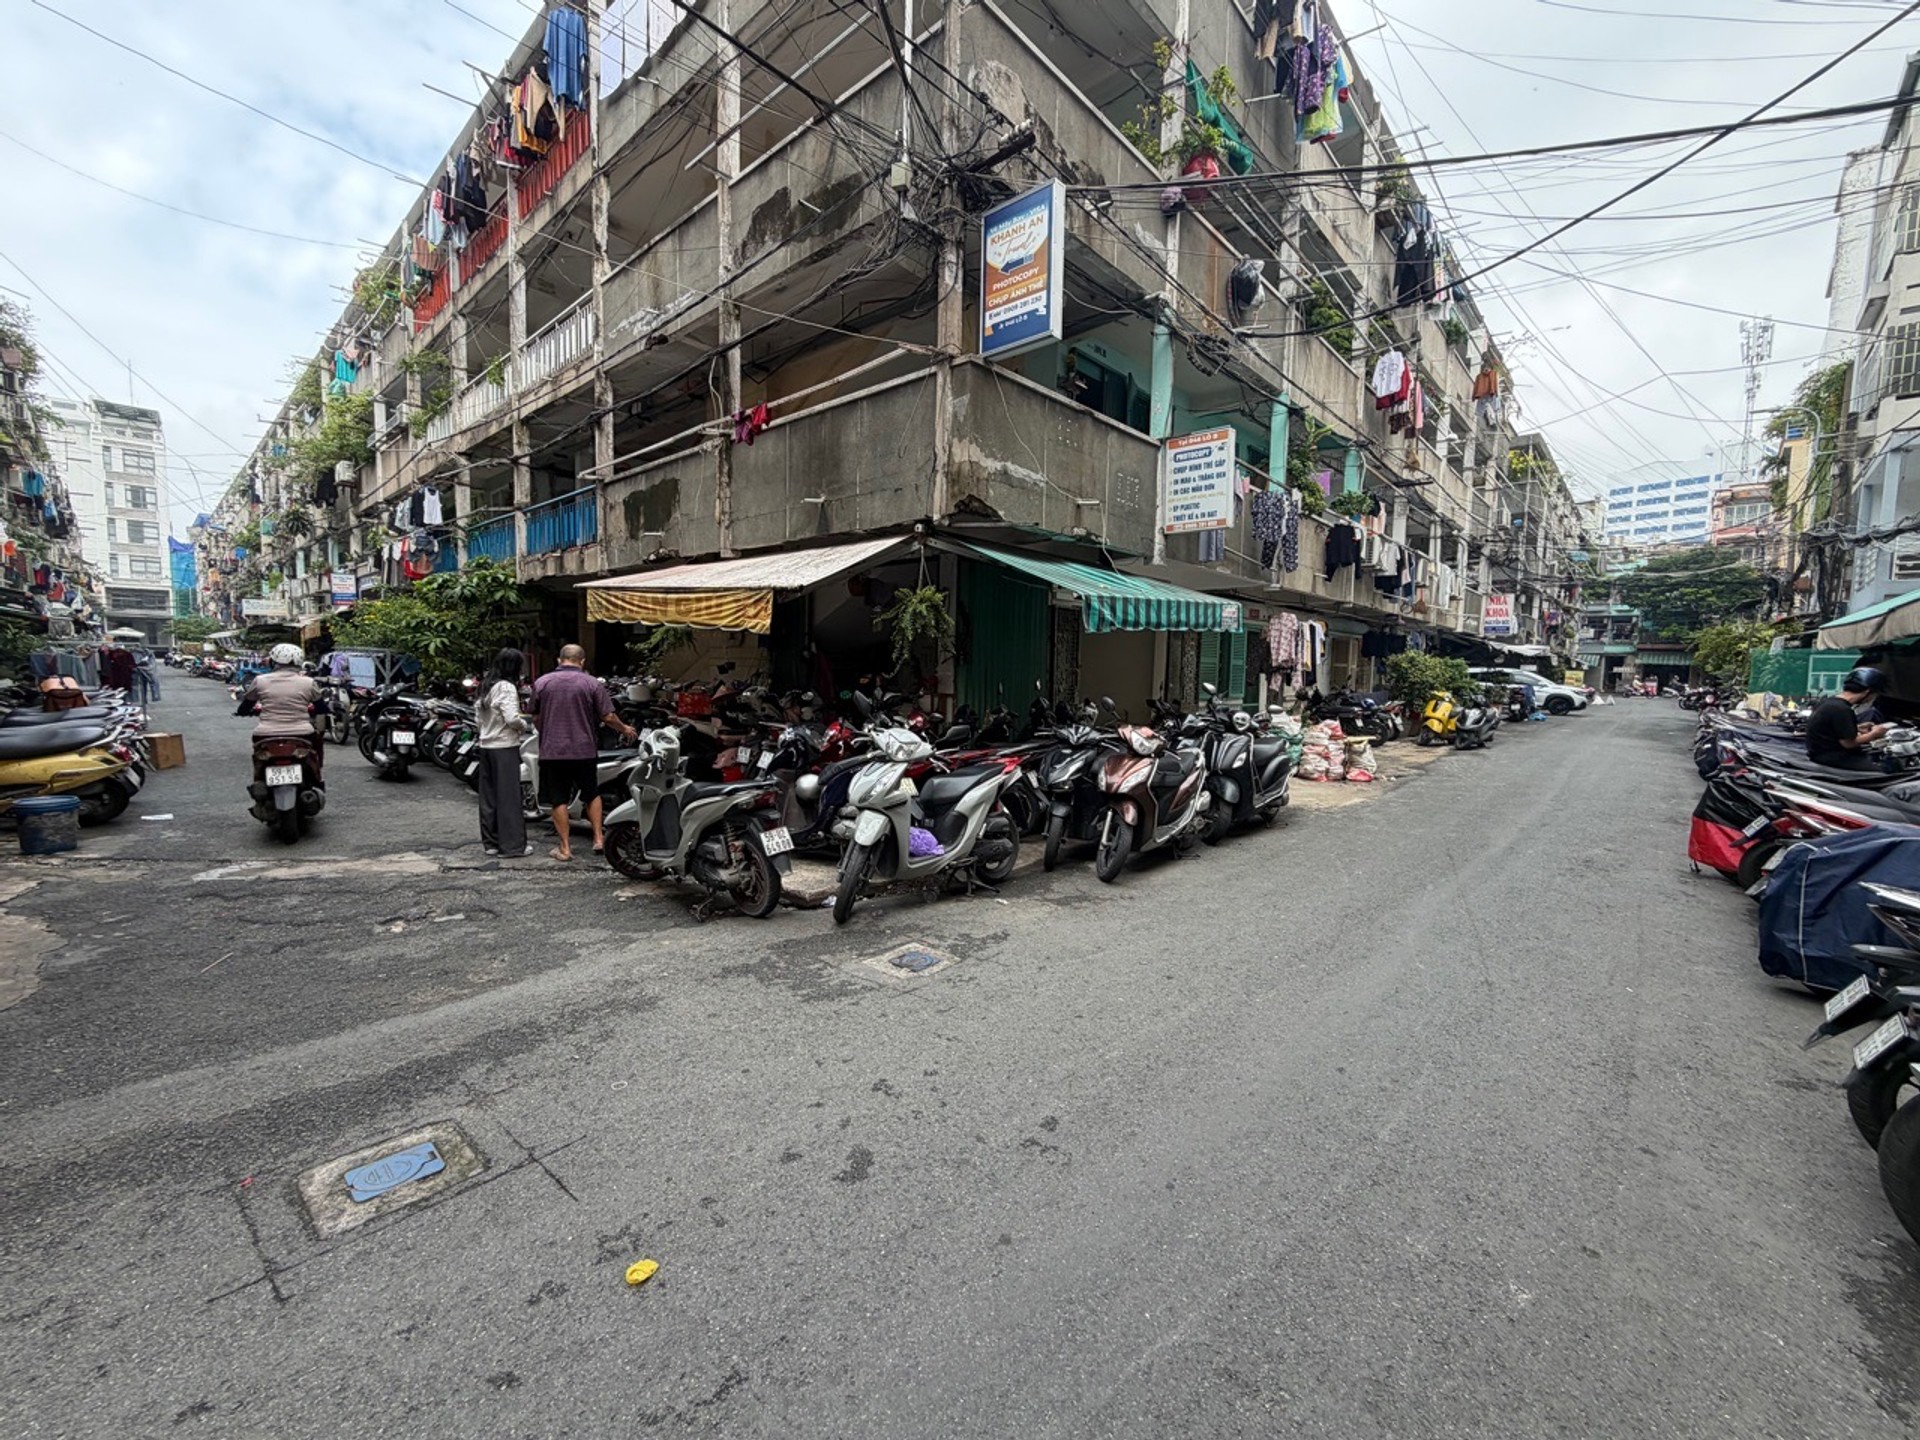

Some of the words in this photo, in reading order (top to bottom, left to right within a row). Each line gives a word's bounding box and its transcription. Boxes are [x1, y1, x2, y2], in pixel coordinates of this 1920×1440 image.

[1028, 214, 1044, 230] AN
[992, 266, 1040, 292] PHOTOCOPY
[1485, 607, 1510, 618] KHOA
